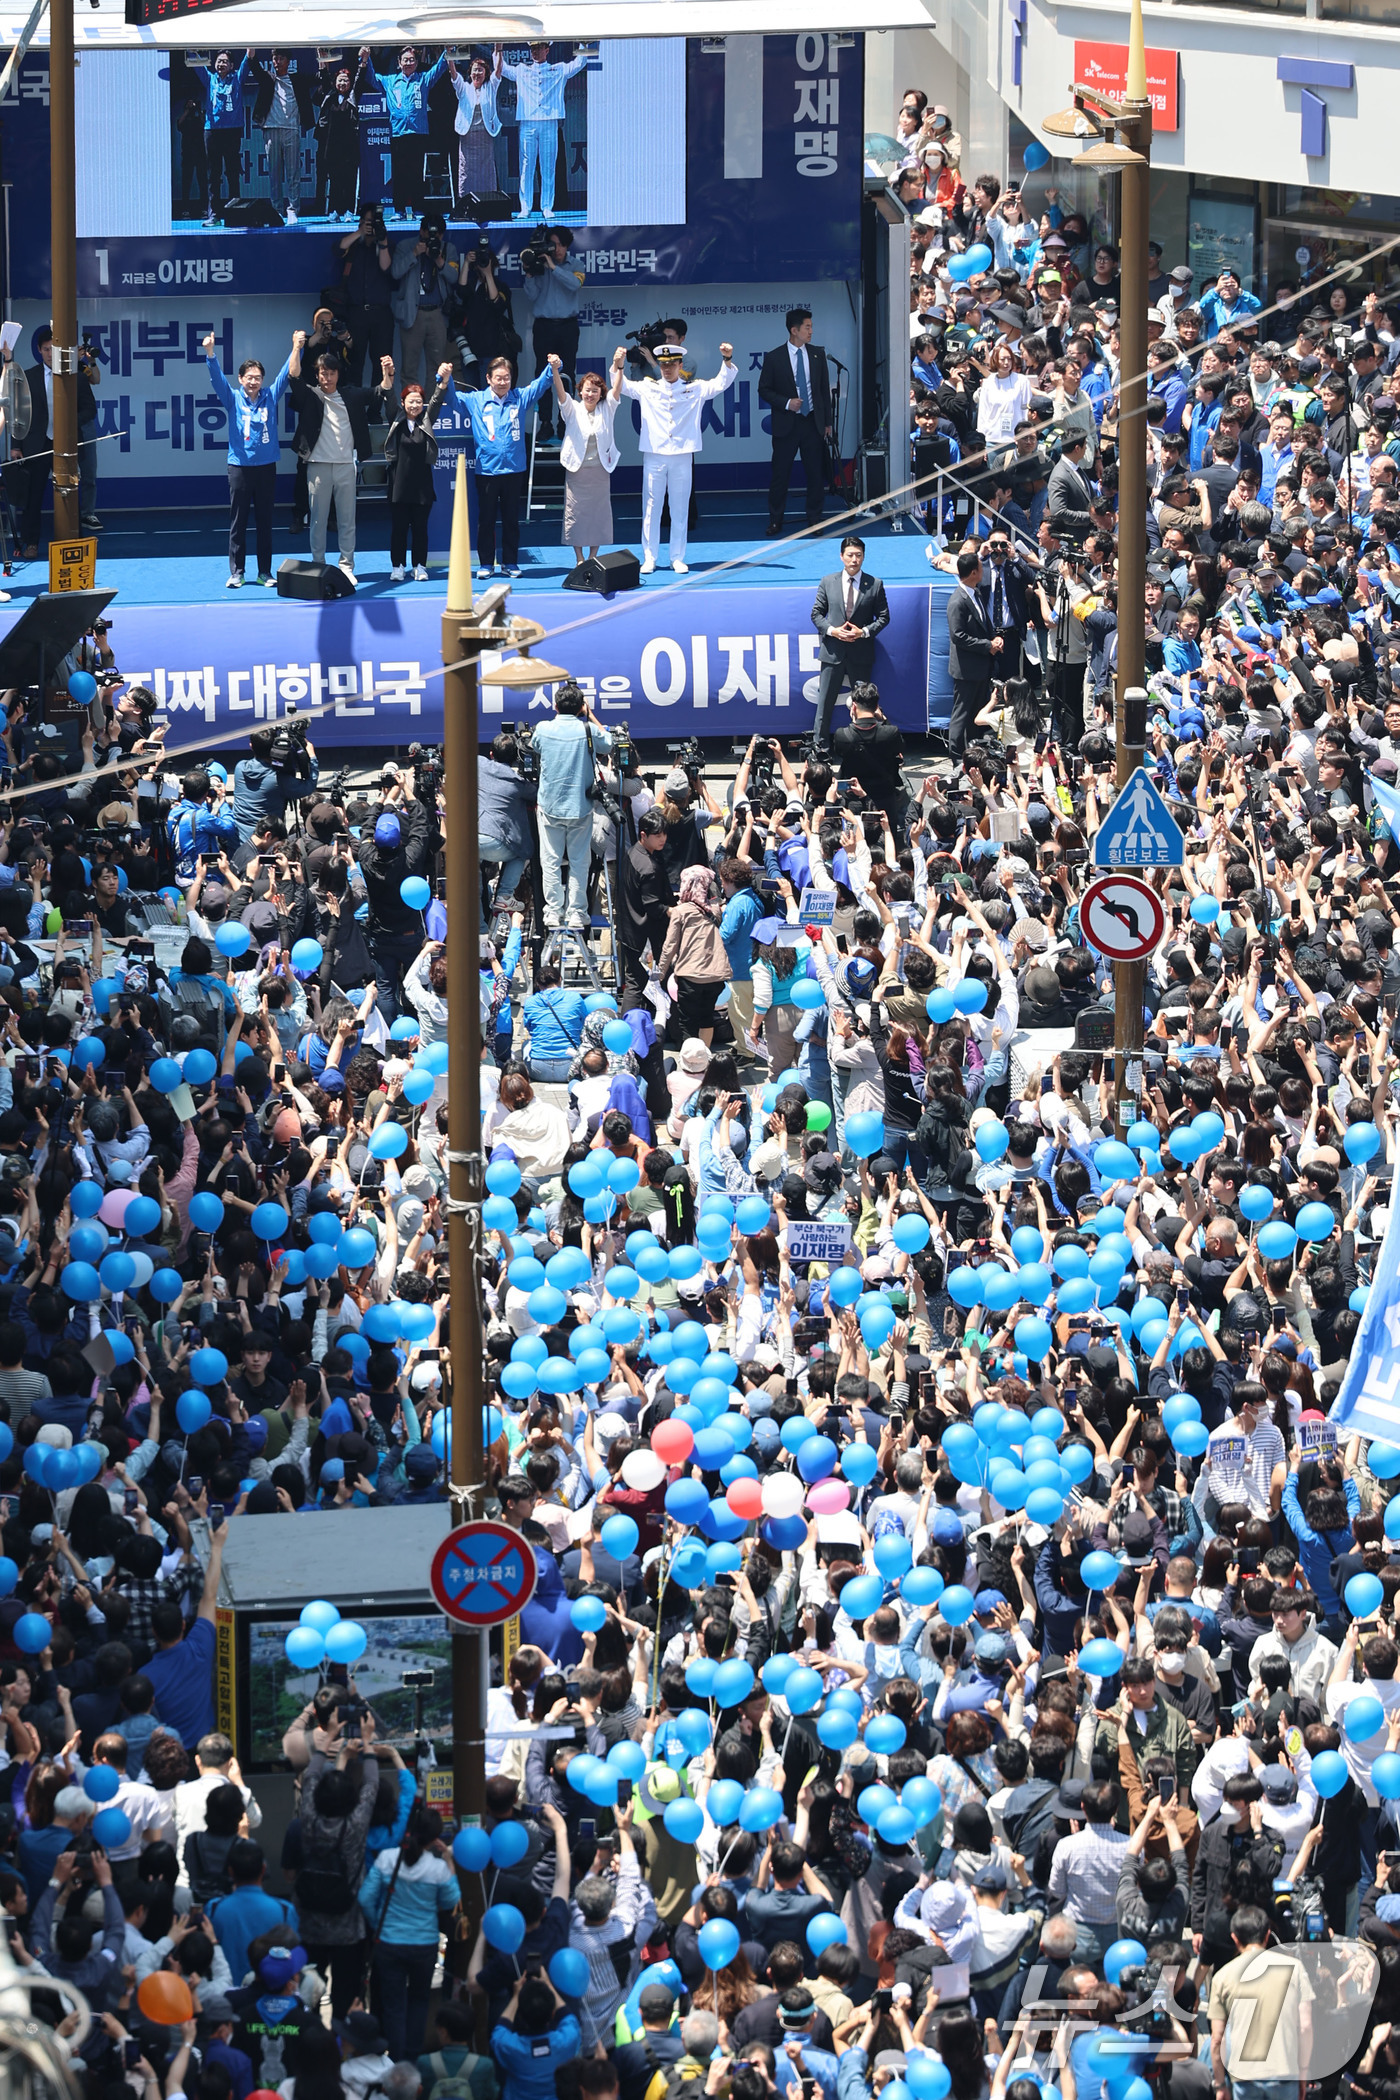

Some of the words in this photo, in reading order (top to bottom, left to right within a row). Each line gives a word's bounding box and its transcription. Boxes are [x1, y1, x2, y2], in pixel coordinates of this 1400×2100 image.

[1084, 68, 1094, 77] SK
[1096, 71, 1120, 80] telecom
[793, 33, 839, 177] 이재명
[95, 249, 109, 285] 1
[121, 272, 156, 285] 지금은
[158, 258, 234, 283] 이재명
[576, 308, 628, 327] 민주당
[681, 306, 728, 316] 더불어민주당
[729, 305, 755, 314] 제21대
[755, 303, 795, 313] 대통령선거
[58, 568, 72, 592] 불법
[228, 660, 426, 720] 대한민국
[1108, 849, 1170, 864] 횡단보도
[810, 902, 834, 911] 이재명
[794, 1223, 814, 1233] 부산
[816, 1224, 845, 1234] 북구가
[790, 1243, 846, 1259] 이재명
[449, 1565, 516, 1582] 주정차금지
[218, 1625, 231, 1739] 한전특고압케이
[430, 1776, 452, 1787] 쓰레기
[430, 1788, 452, 1799] 무단투
